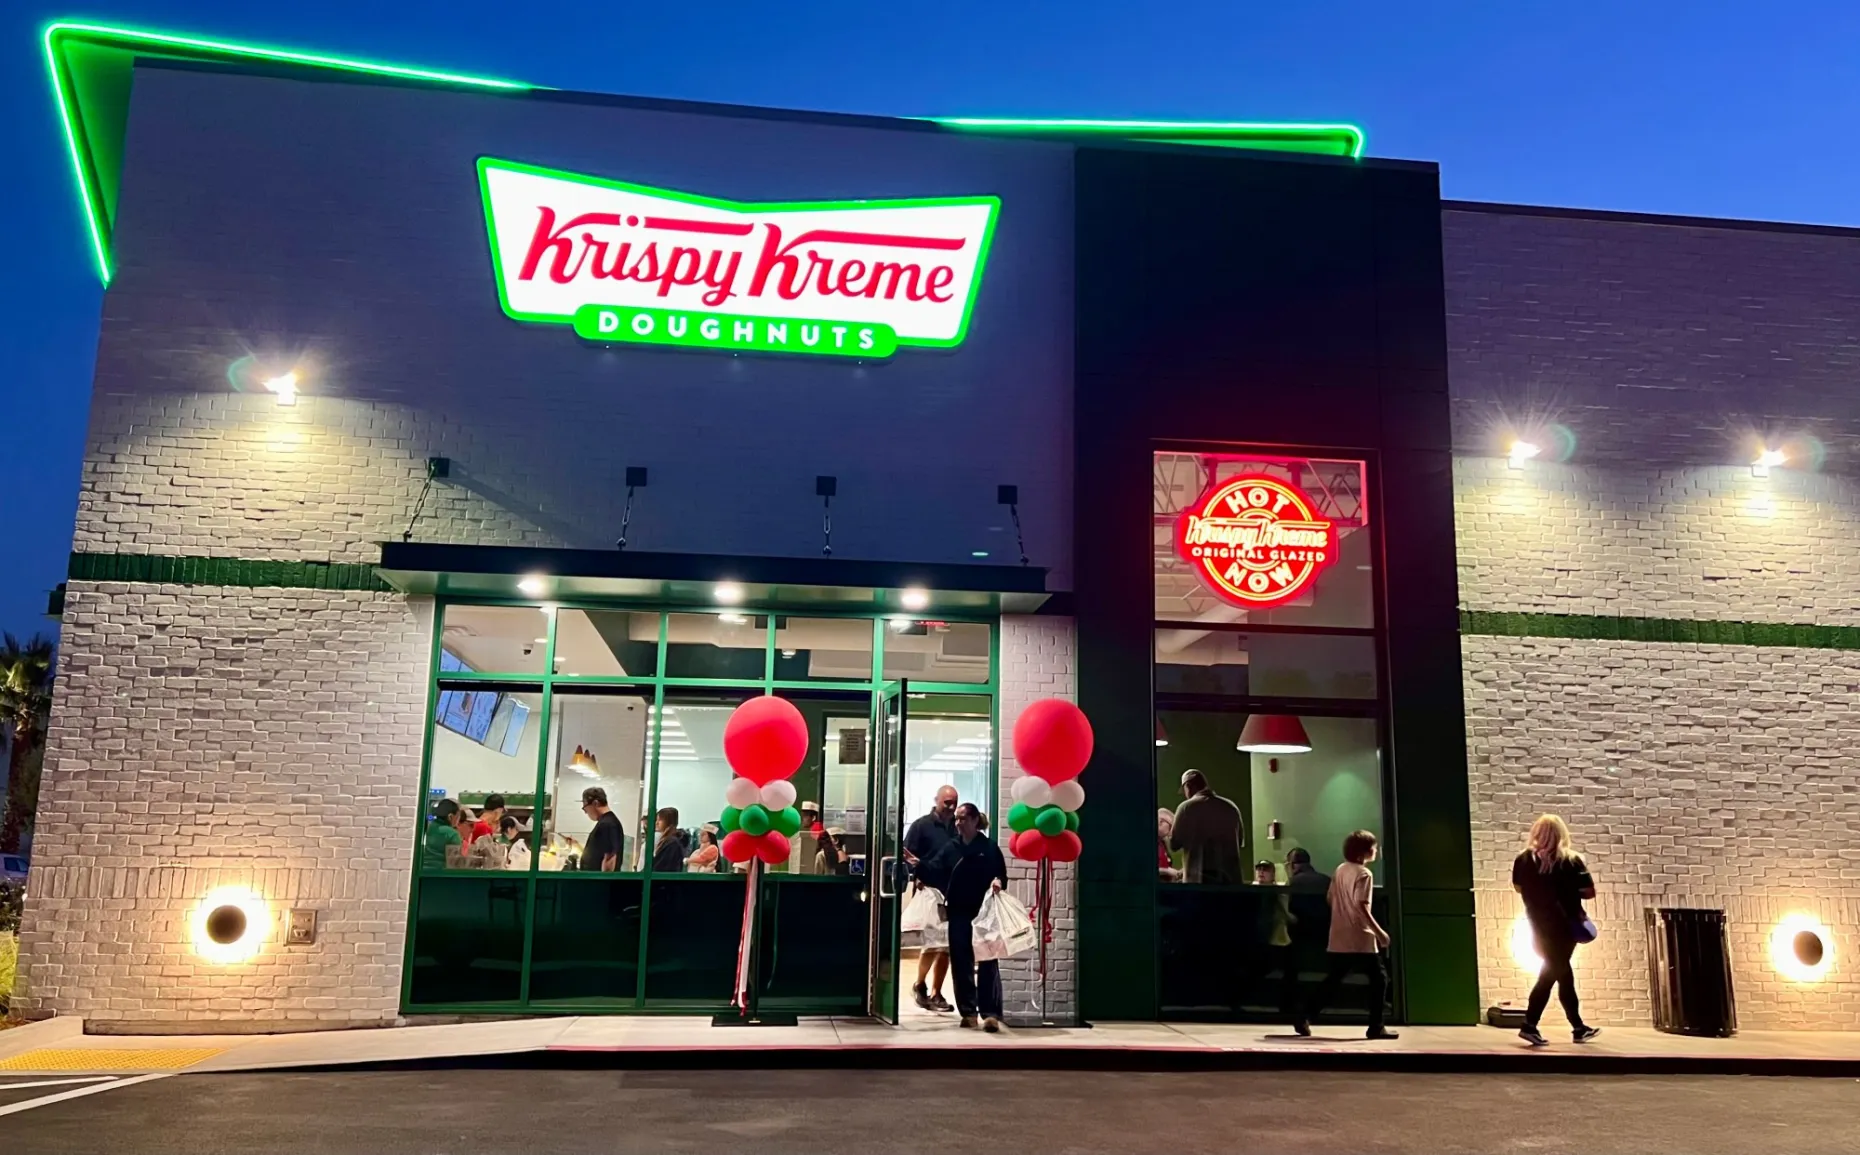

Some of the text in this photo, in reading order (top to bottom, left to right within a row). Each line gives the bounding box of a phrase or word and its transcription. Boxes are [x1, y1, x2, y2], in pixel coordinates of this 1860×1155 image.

[518, 206, 966, 307] Krispy Kreme
[598, 310, 875, 350] DOUGHNUTS
[1224, 486, 1291, 514] HOT
[1258, 519, 1330, 548] Kreme
[1191, 546, 1326, 563] ORIGINAL GLAZED
[1223, 561, 1295, 593] NOW
